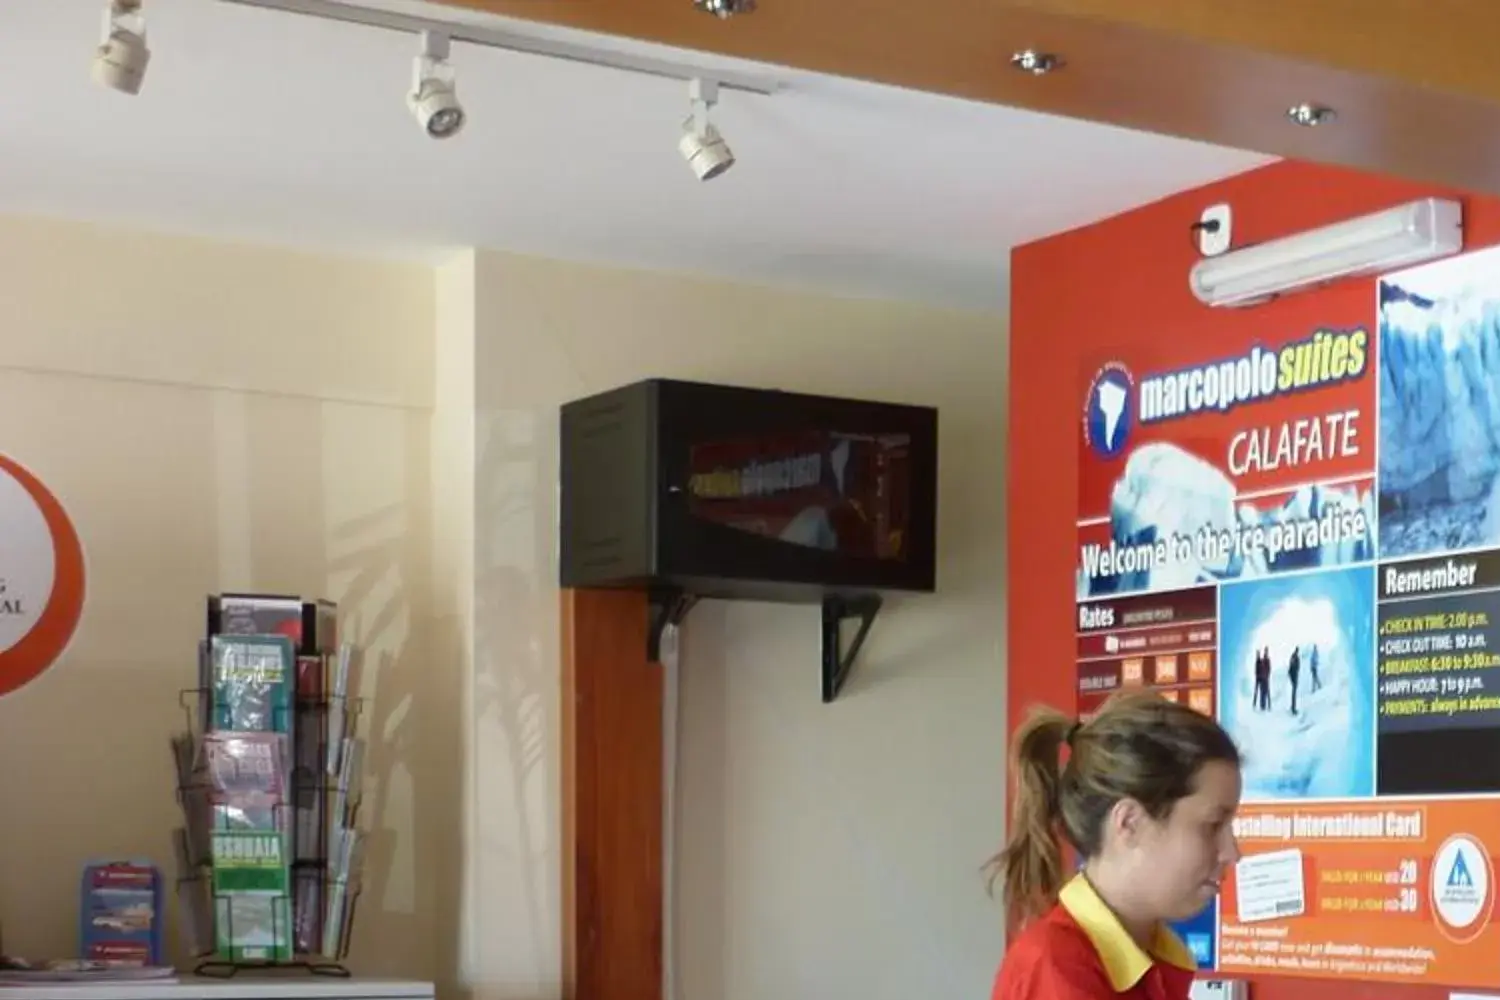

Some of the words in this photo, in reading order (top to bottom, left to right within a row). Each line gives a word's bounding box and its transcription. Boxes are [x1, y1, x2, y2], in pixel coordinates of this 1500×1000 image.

[1228, 410, 1360, 475] CALAFATE
[1082, 541, 1165, 578] Welcome
[1168, 535, 1193, 567] to
[1197, 520, 1235, 562] the
[1236, 522, 1270, 556] ice
[1269, 501, 1366, 562] paradise
[1385, 559, 1477, 595] Remember
[1079, 605, 1114, 629] Rates
[1385, 617, 1412, 634] CHECK
[1385, 638, 1411, 655] CHECK
[1412, 636, 1429, 653] OUT
[1293, 812, 1383, 838] International
[1386, 811, 1421, 837] Card
